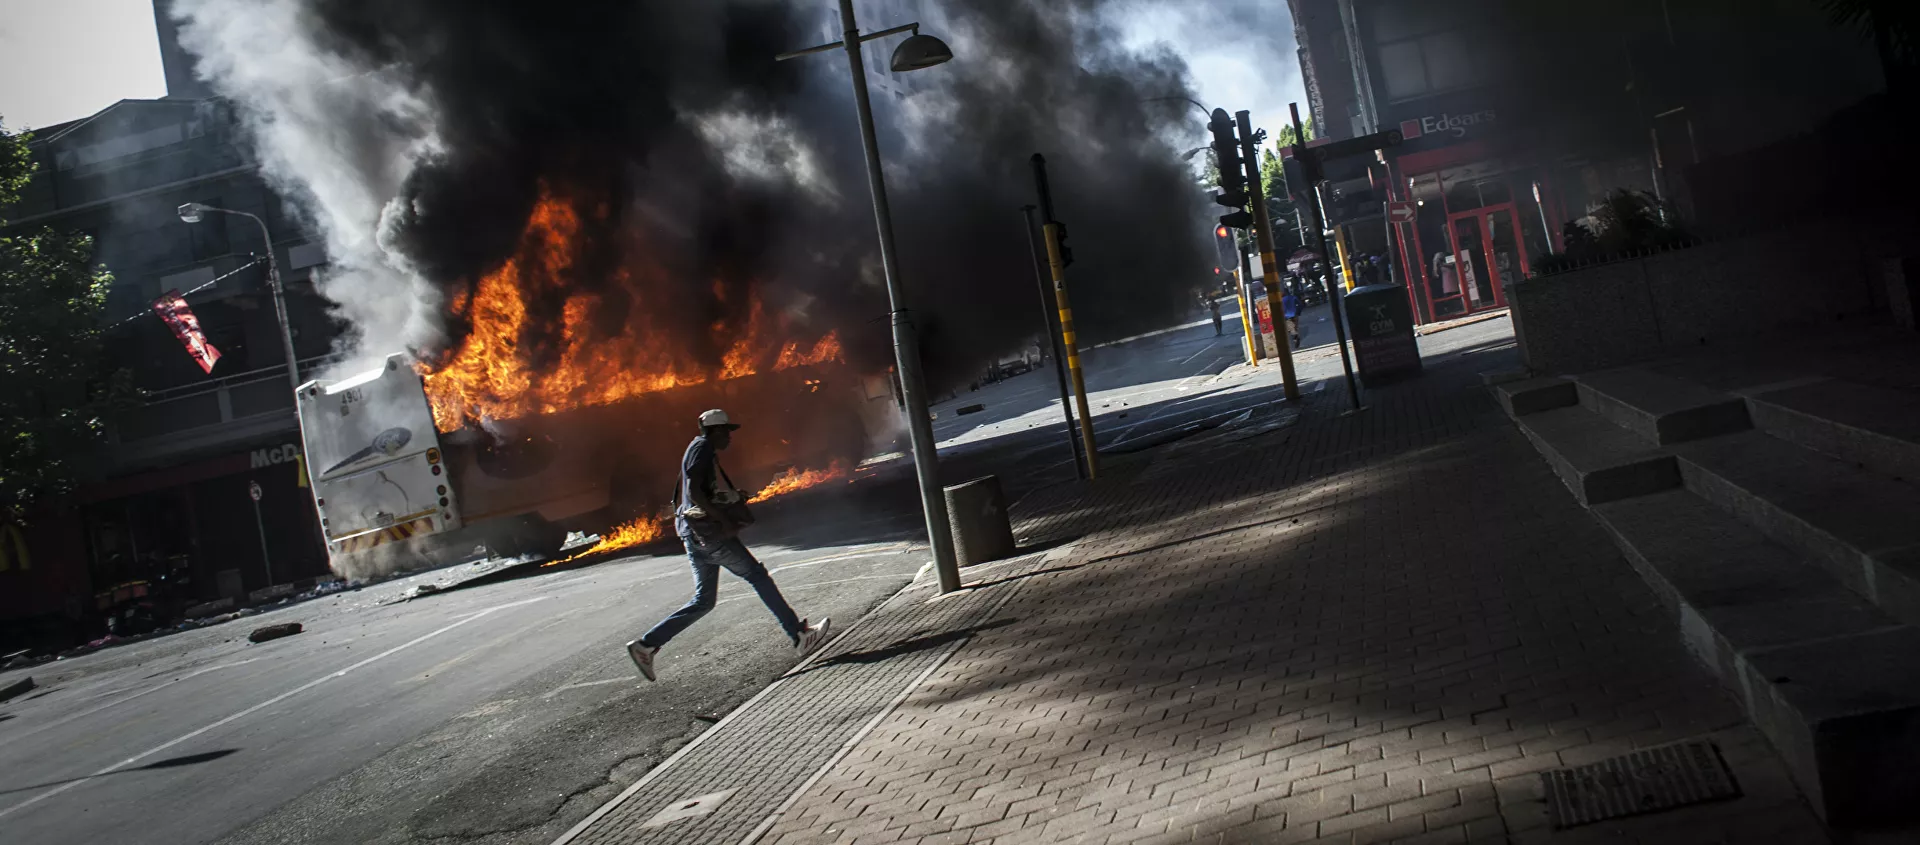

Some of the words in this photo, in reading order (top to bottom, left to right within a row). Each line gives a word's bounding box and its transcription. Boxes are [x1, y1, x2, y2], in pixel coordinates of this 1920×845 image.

[1421, 109, 1496, 138] Edgars
[1369, 319, 1395, 331] GYM
[341, 388, 363, 405] 4901
